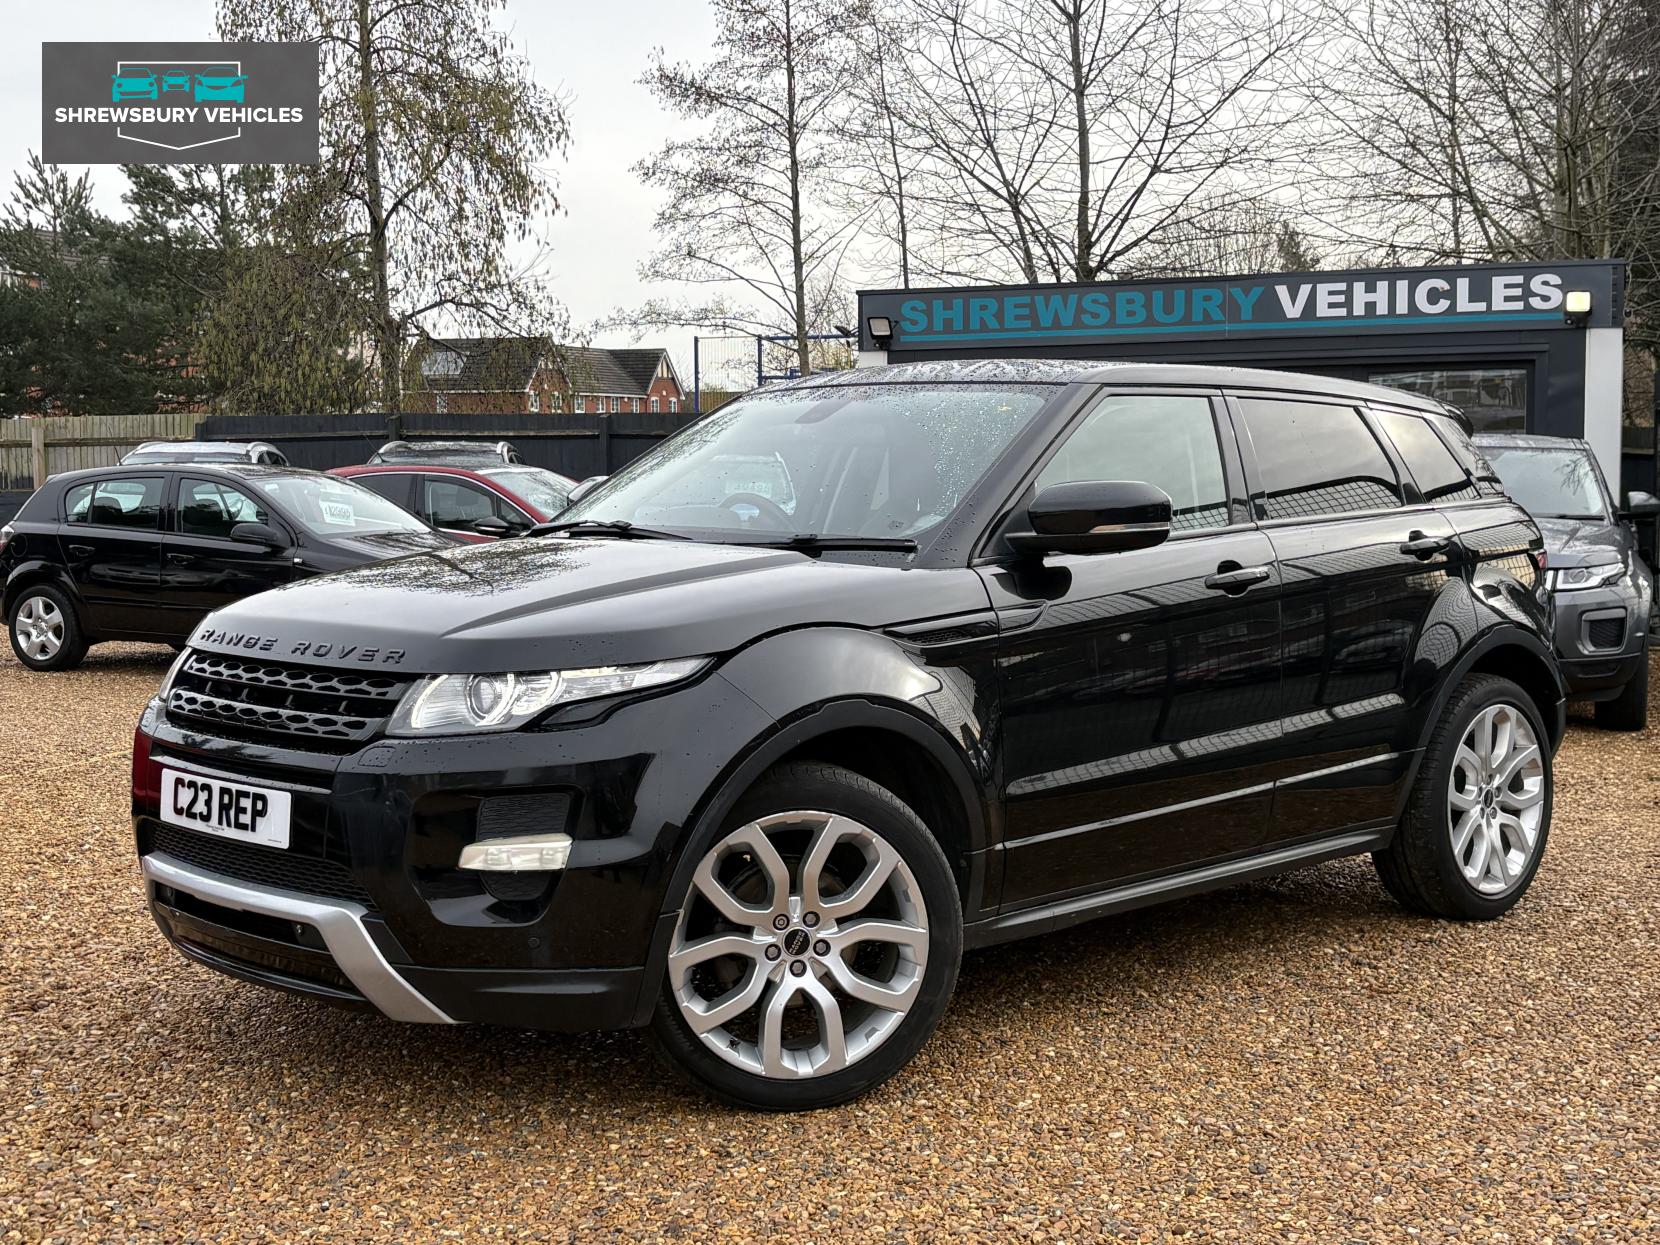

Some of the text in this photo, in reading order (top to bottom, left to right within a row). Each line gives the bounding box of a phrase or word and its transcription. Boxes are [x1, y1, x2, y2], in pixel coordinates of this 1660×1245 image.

[900, 273, 1564, 333] SHREWSBURY VEHICLES
[200, 628, 406, 665] RANGE ROVER
[173, 776, 269, 833] C23 REP
